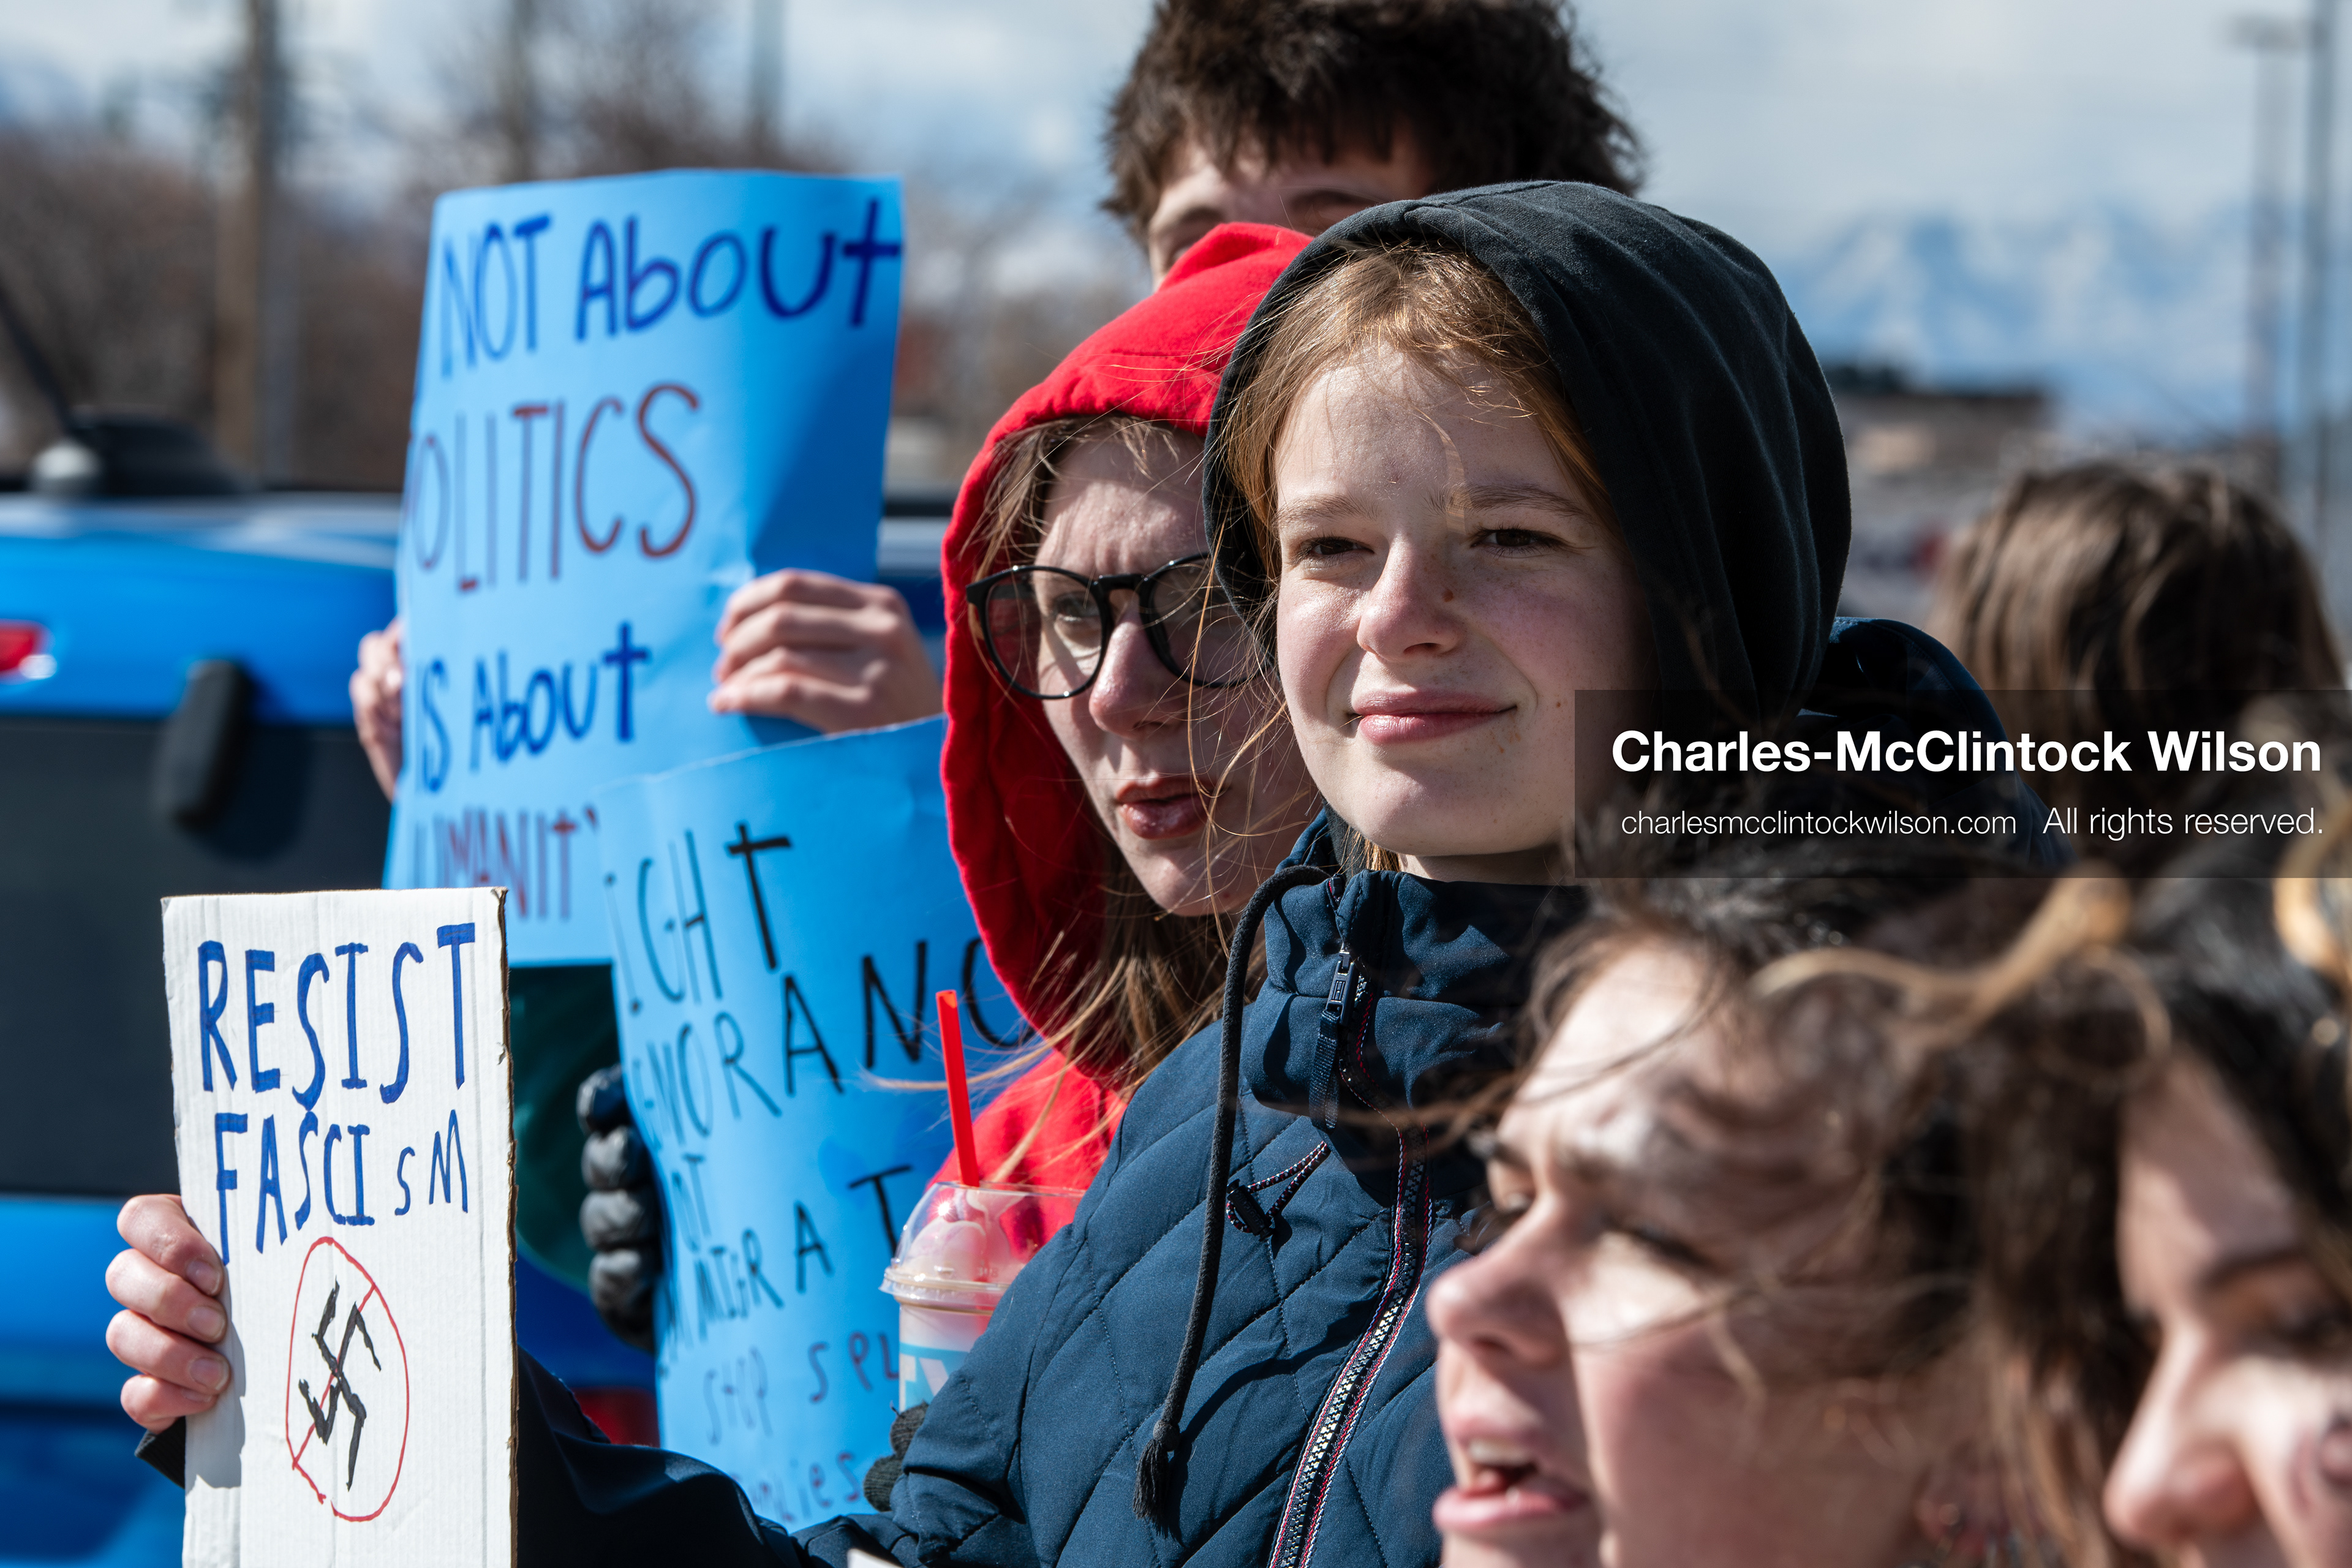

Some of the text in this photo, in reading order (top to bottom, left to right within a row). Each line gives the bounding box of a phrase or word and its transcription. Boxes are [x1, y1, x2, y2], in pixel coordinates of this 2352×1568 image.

[439, 214, 552, 380] NOT
[405, 383, 699, 593] OLITICS
[603, 821, 792, 1011] IGHT
[198, 922, 475, 1112] RESIST
